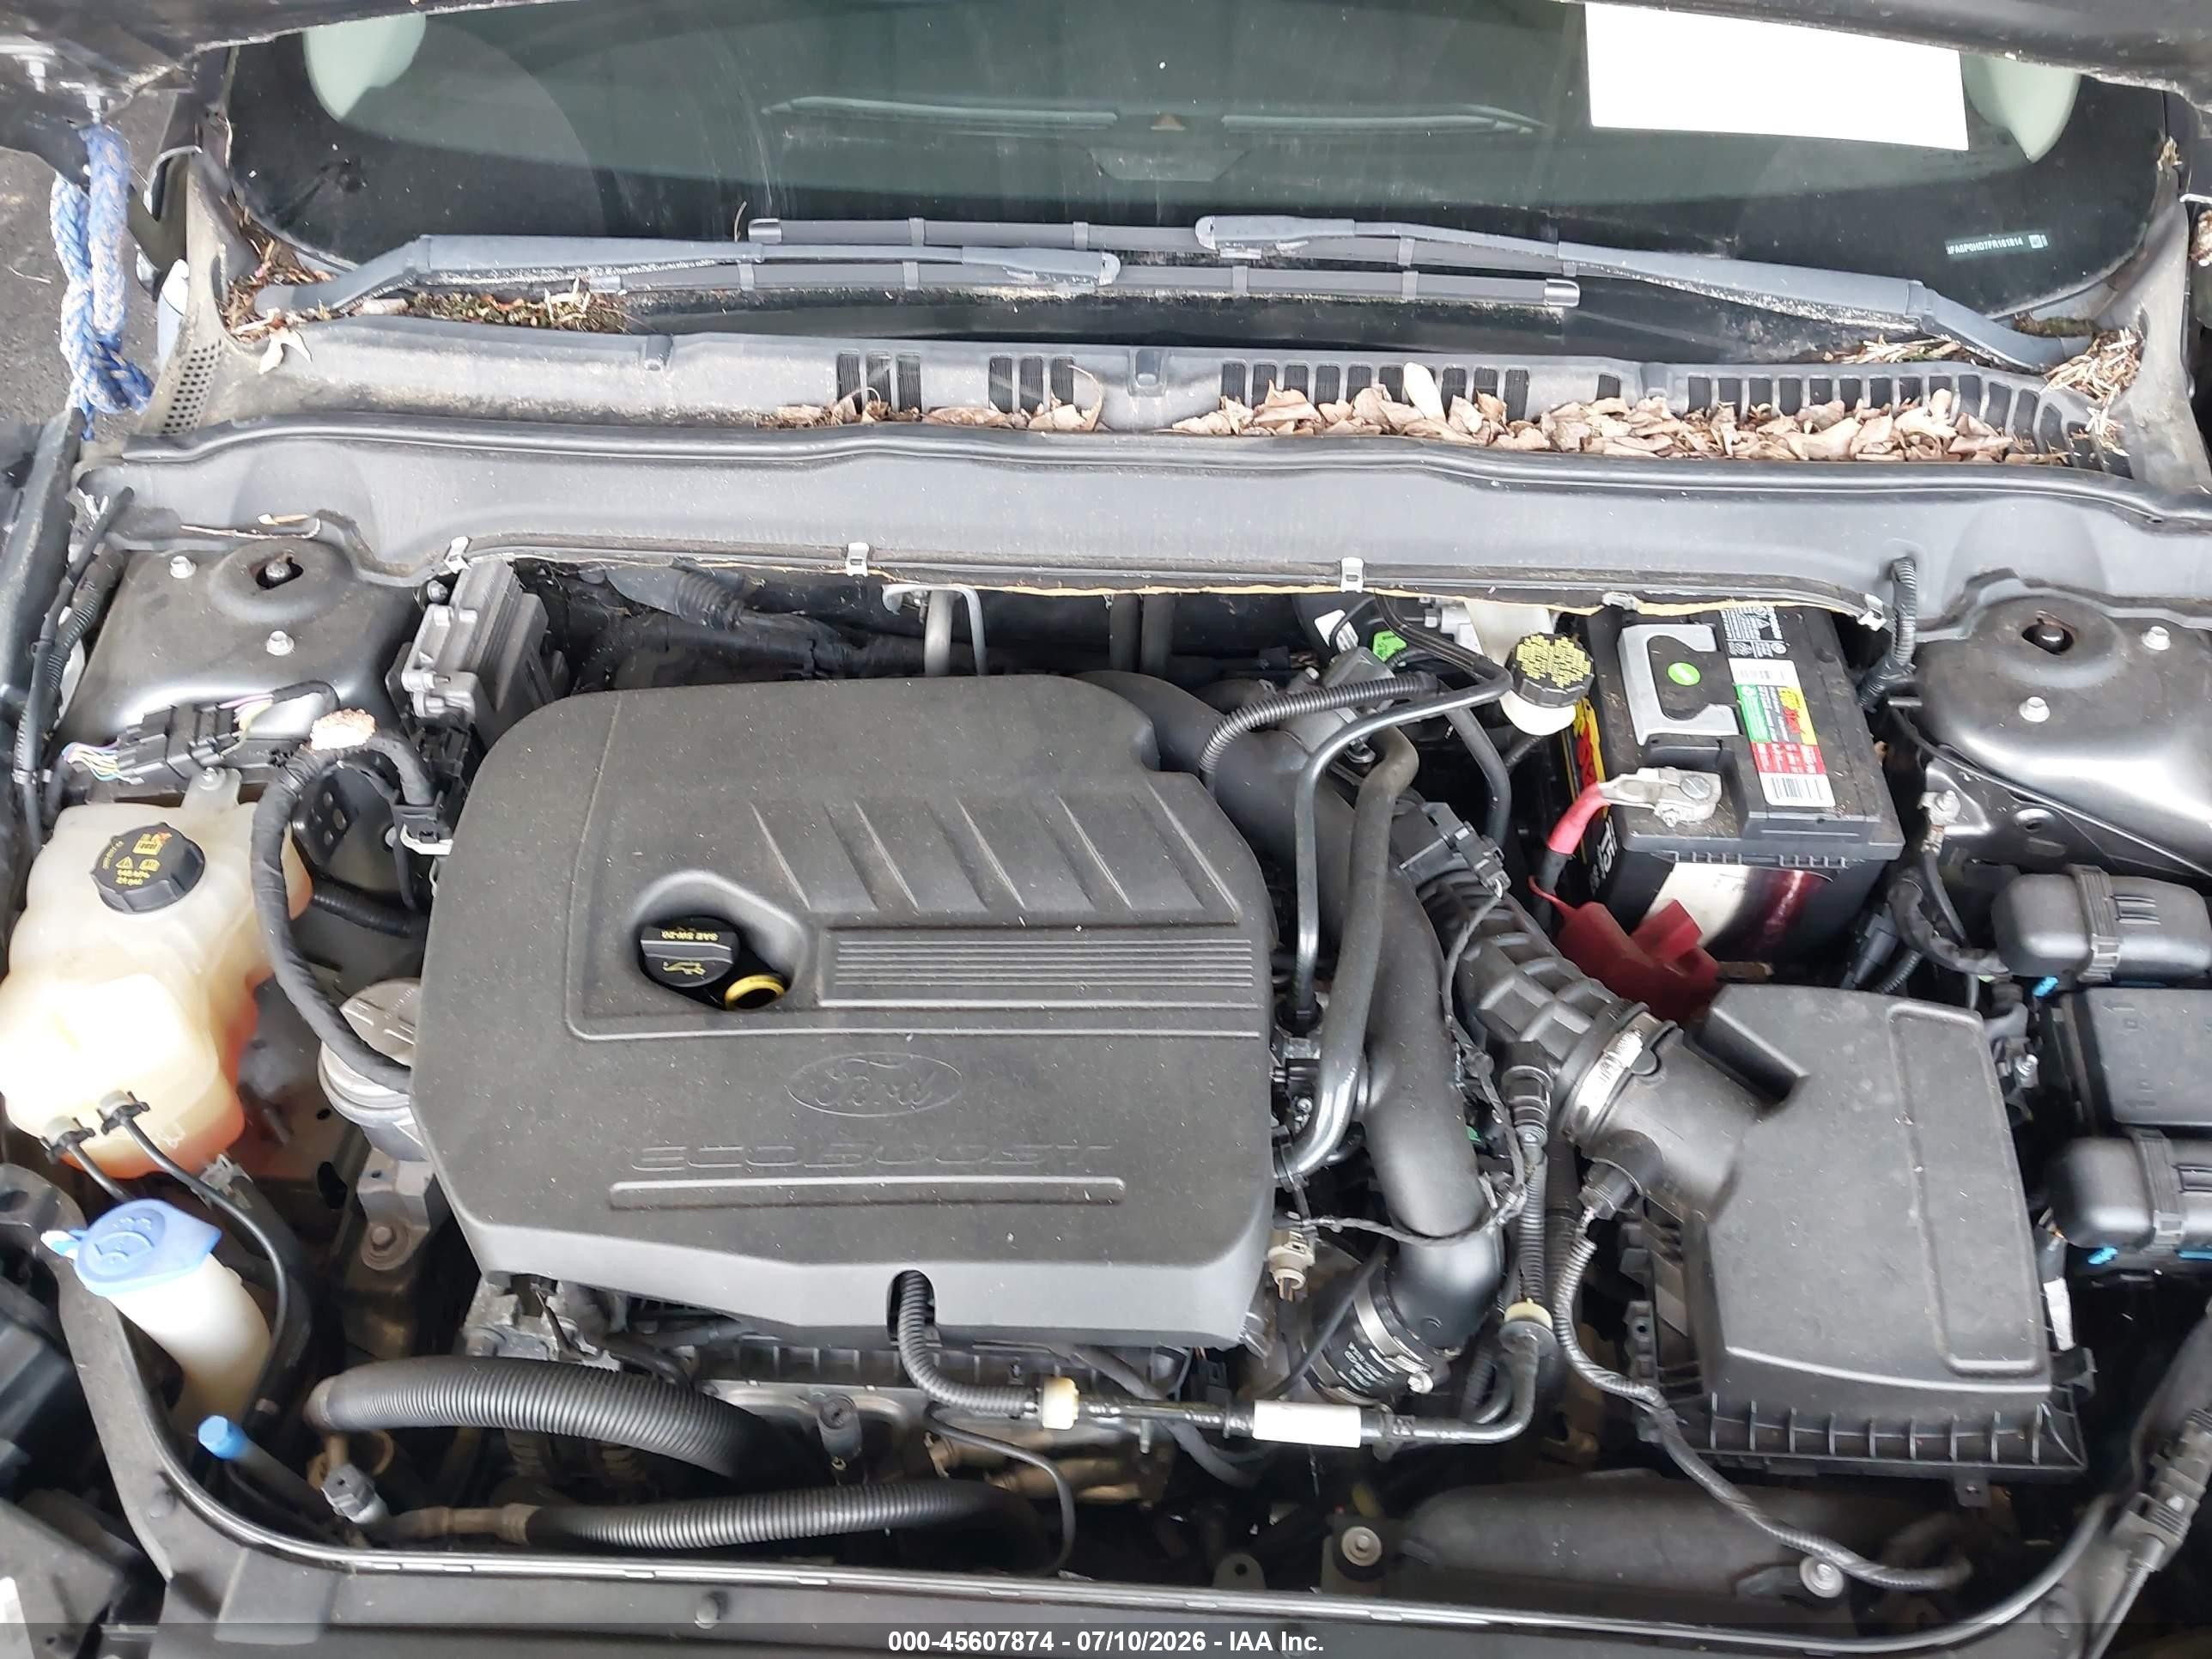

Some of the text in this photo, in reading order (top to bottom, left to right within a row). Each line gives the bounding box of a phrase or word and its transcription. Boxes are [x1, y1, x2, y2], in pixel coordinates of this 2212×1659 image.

[695, 931, 720, 941] SAE
[814, 1057, 937, 1109] Ford
[631, 1144, 1114, 1171] ECOBOOST
